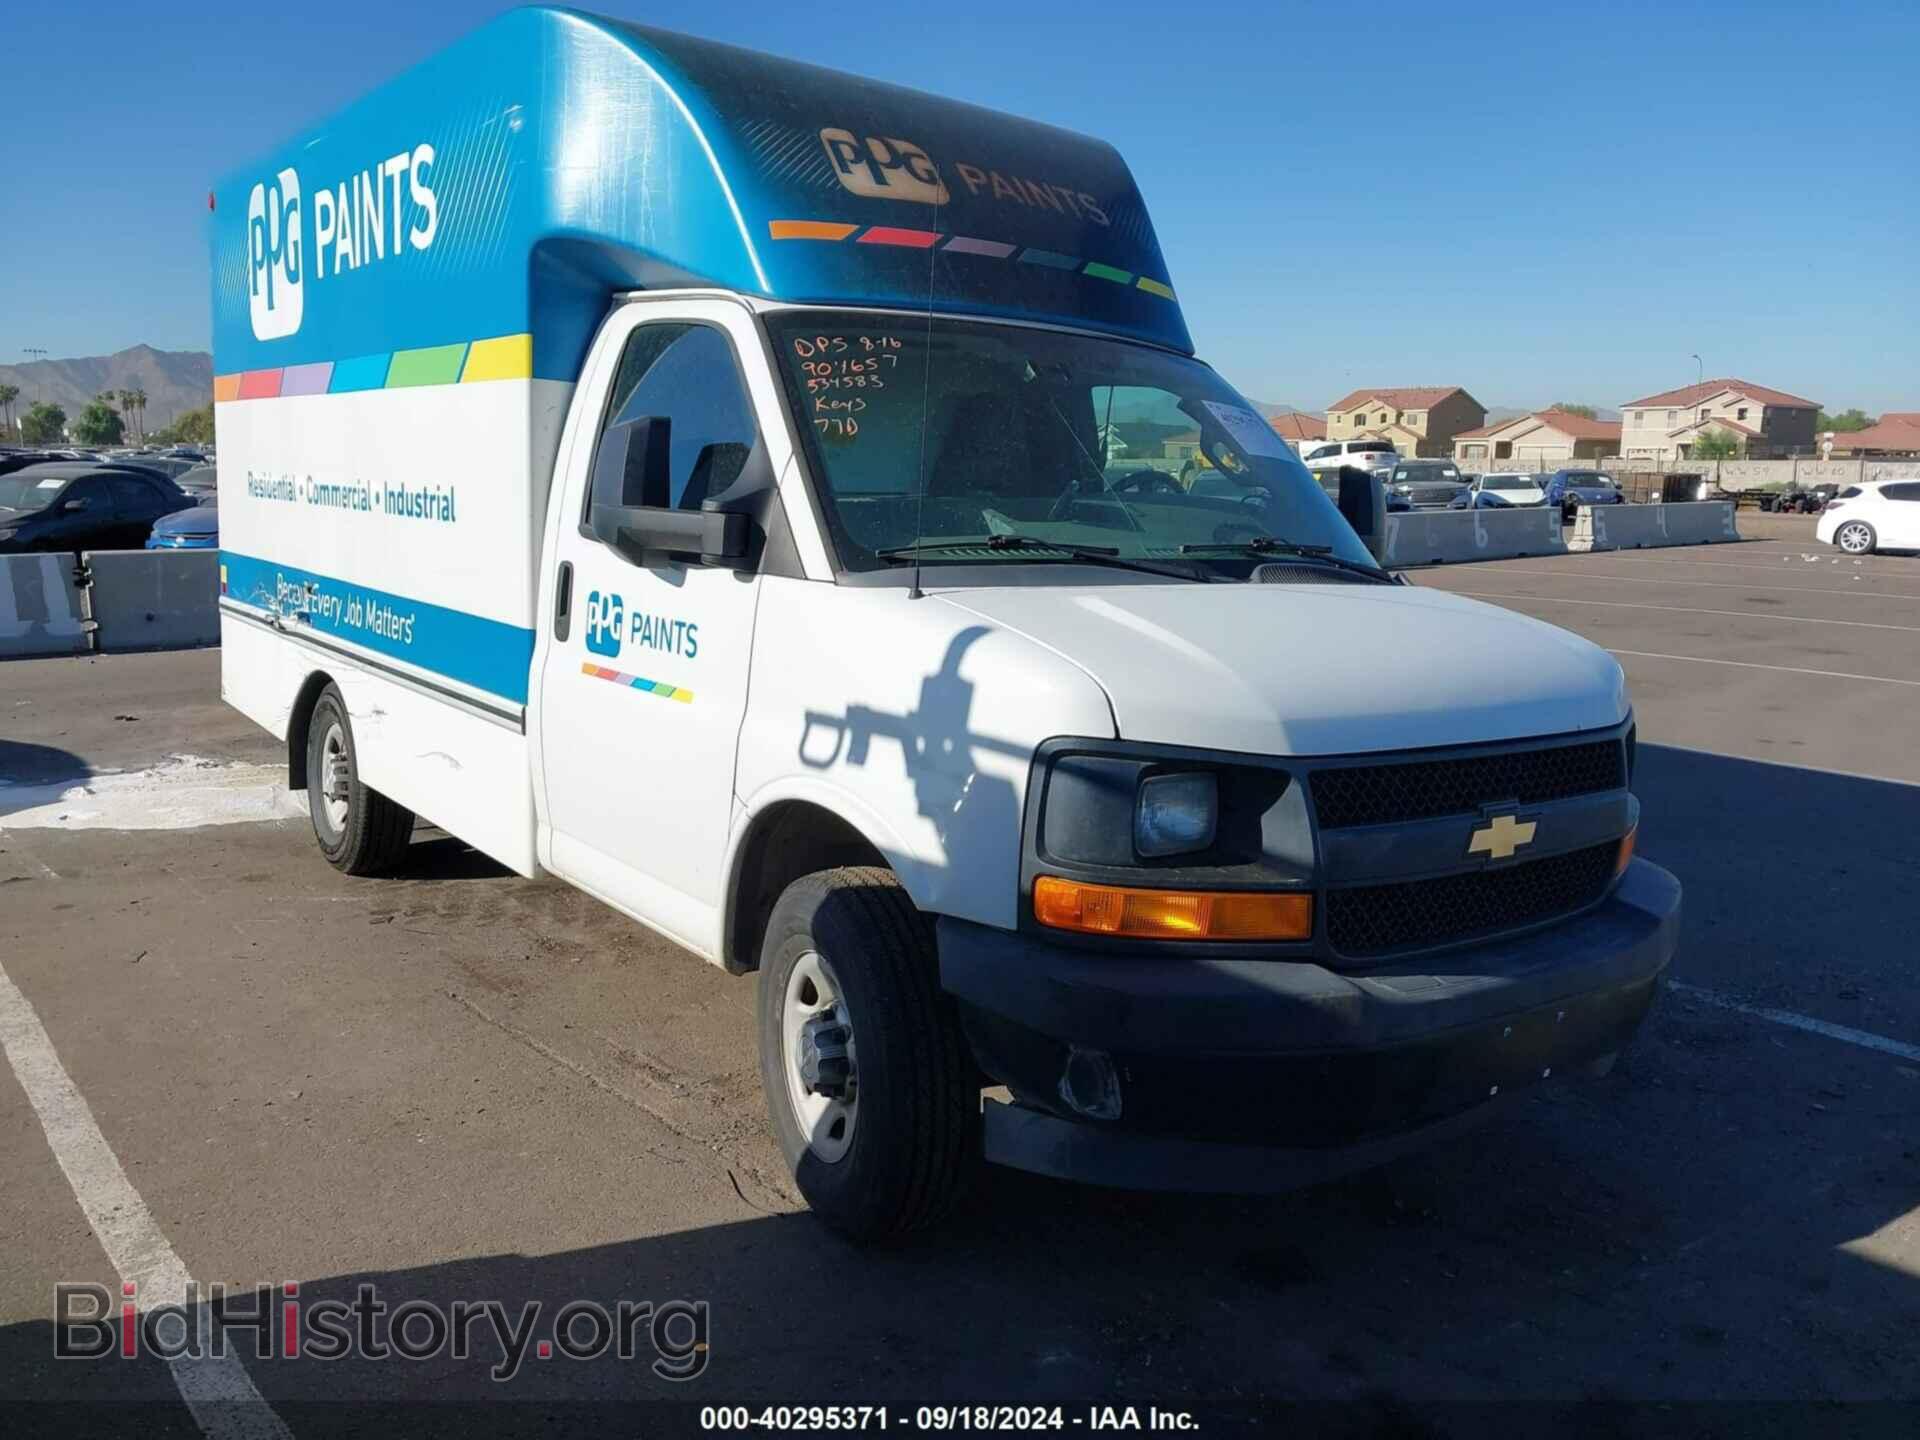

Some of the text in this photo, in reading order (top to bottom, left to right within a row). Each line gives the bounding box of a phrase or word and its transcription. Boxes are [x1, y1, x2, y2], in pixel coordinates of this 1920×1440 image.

[822, 130, 1111, 227] PPG PAINTS
[249, 143, 437, 318] PPG PAINTS
[794, 336, 848, 357] DPS
[815, 395, 867, 413] Keys
[247, 471, 456, 523] Residential Commercial Industrial
[311, 583, 343, 627] Every
[344, 592, 363, 628] Job
[586, 591, 698, 658] PPG PAINTS
